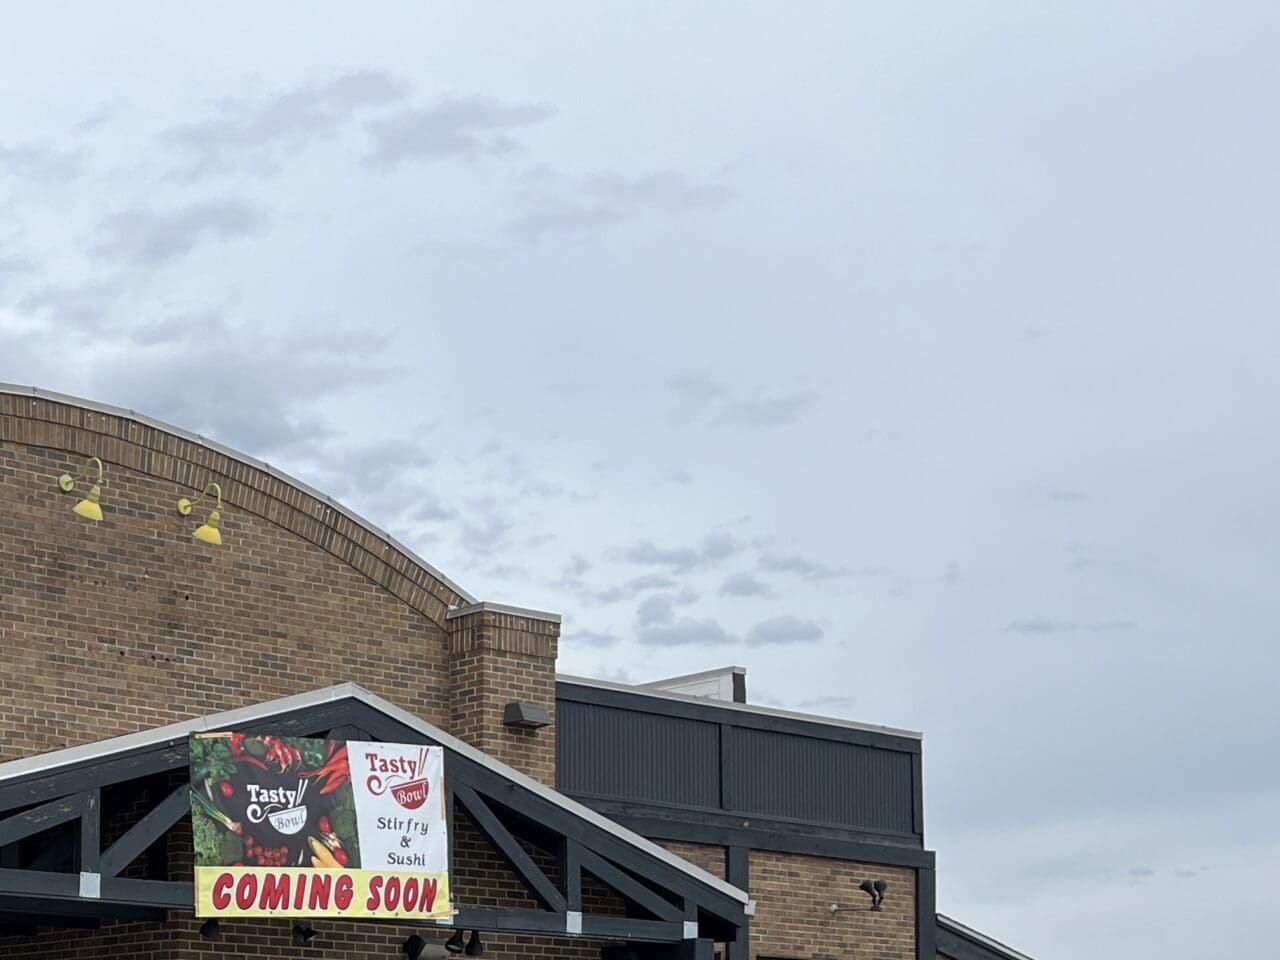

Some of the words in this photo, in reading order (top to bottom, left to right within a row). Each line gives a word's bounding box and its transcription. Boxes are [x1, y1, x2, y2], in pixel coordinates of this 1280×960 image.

[365, 753, 417, 779] Tasty
[247, 785, 297, 808] Tasty
[396, 783, 430, 806] Bowl
[276, 808, 307, 829] Bowl
[399, 836, 412, 848] &
[386, 852, 426, 867] Sushi
[211, 872, 354, 911] COMING
[366, 875, 438, 912] SOON
